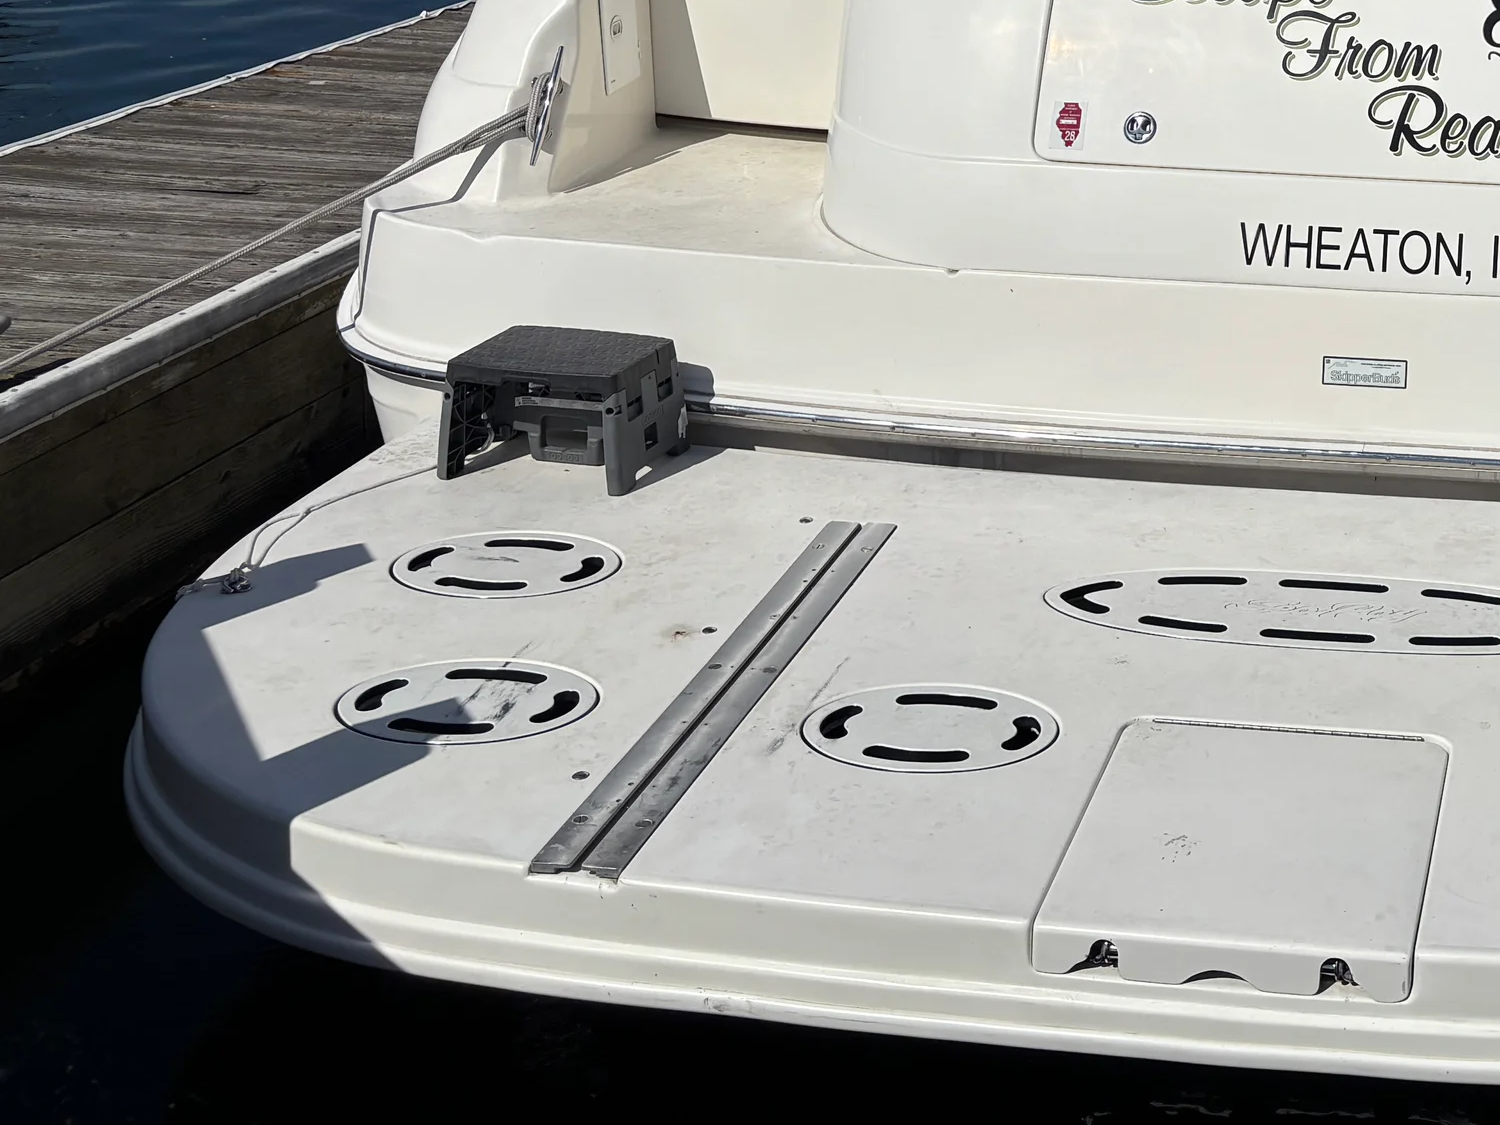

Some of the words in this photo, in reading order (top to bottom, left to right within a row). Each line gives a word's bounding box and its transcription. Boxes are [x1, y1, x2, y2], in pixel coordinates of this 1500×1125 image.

[1275, 9, 1443, 81] From
[1064, 130, 1076, 142] 28
[1240, 221, 1472, 286] WHEATON,
